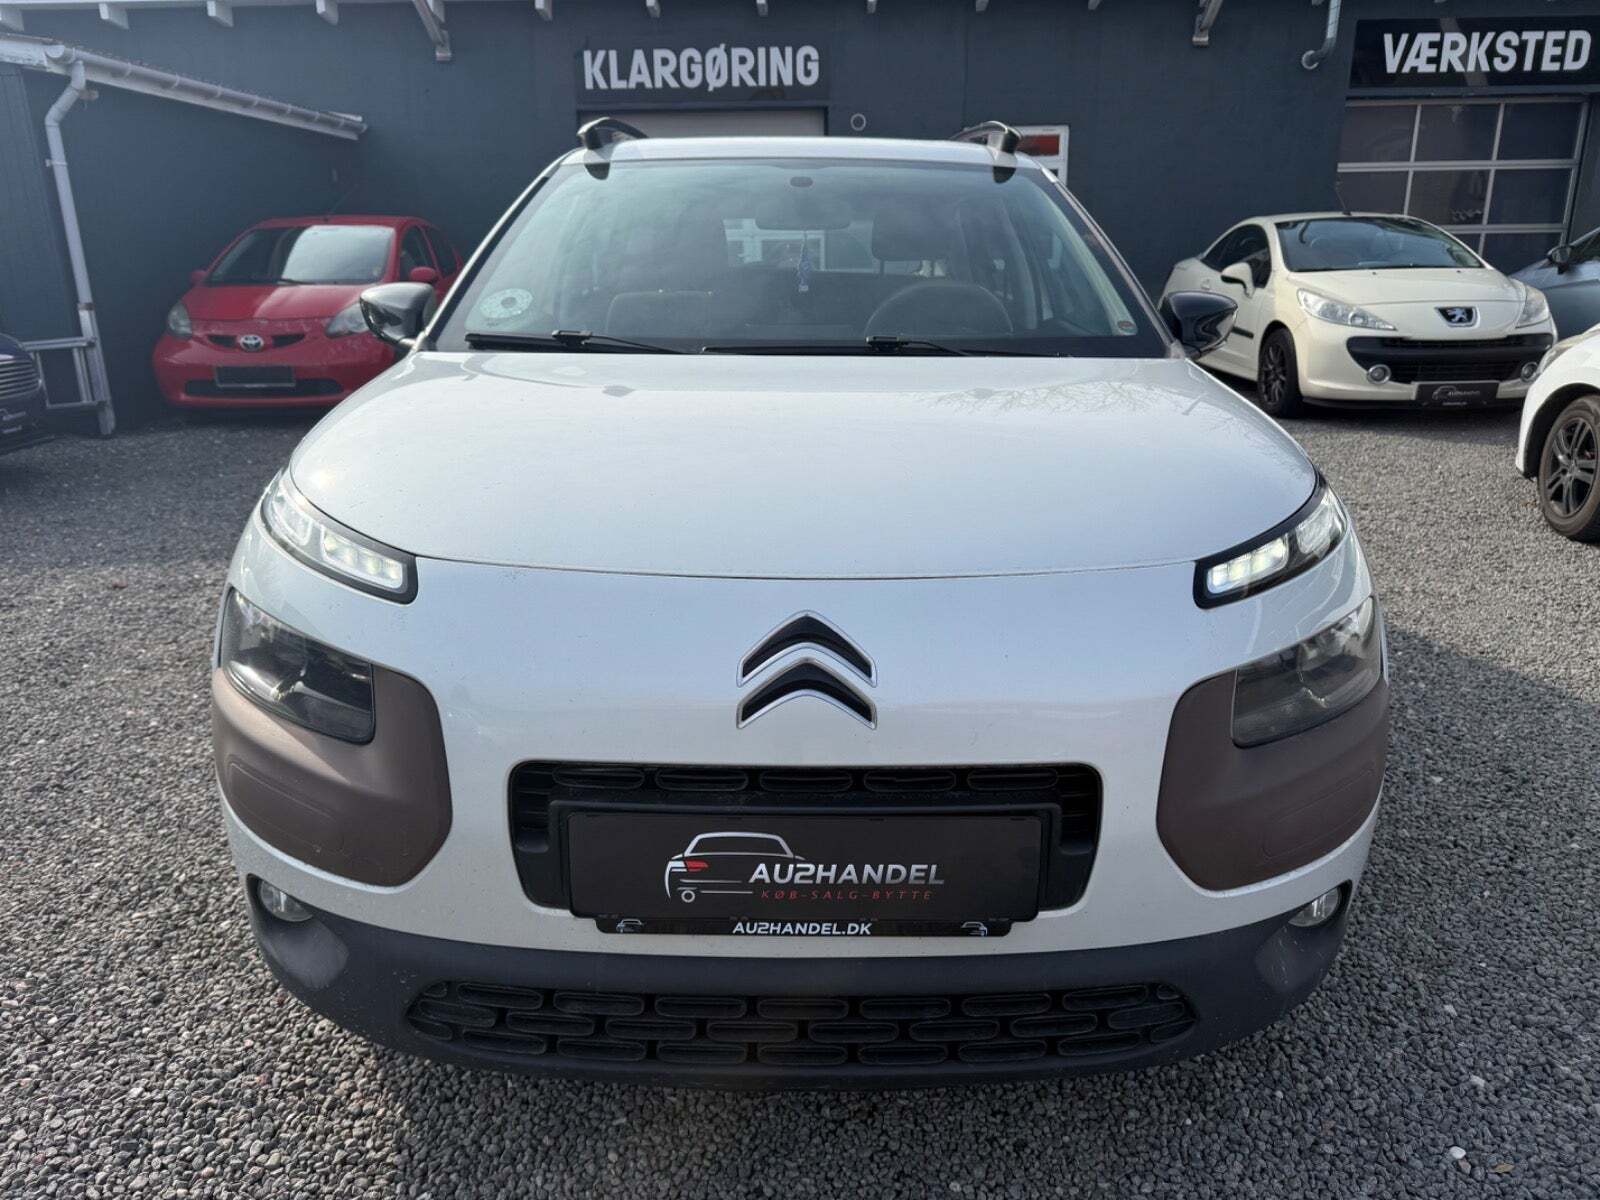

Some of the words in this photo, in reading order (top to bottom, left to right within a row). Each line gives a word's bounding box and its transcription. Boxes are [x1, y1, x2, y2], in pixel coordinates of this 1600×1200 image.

[583, 43, 820, 91] KLARGØRING
[1383, 29, 1592, 73] VÆRKSTED
[749, 863, 945, 884] AU2HANDEL
[732, 921, 873, 936] AU2HANDEL.DK
